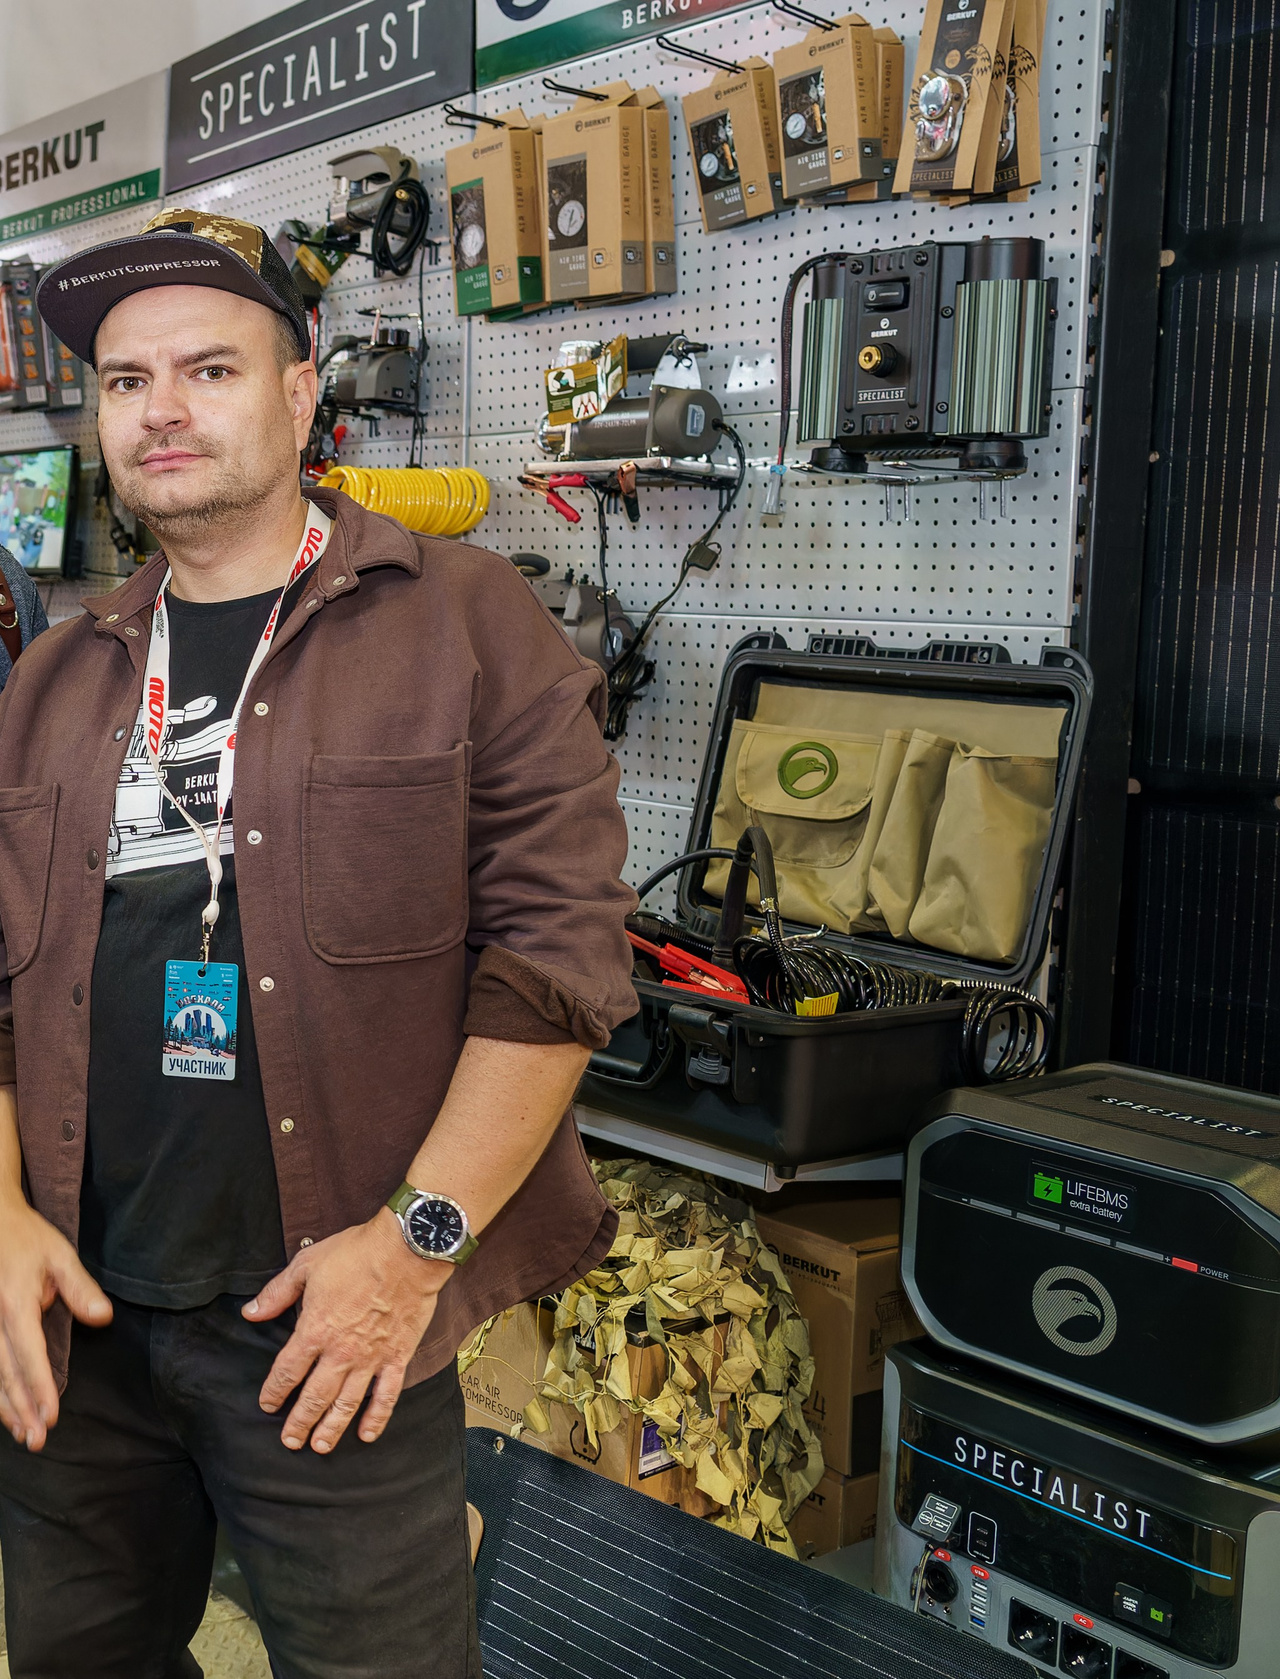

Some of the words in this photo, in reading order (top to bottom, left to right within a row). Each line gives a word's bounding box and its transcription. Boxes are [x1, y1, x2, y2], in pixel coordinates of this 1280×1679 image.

[621, 0, 703, 30] BERKU
[946, 9, 977, 22] BERKUT
[198, 1, 426, 141] SPECIALIST
[51, 181, 146, 225] PROFESSIONAL
[870, 328, 898, 339] BERKUT
[858, 389, 905, 402] SPECIALIST
[148, 677, 165, 755] MOTO
[169, 1058, 227, 1076] УЧАСТНИК
[1101, 1096, 1262, 1137] SPECIALIST
[1066, 1179, 1129, 1210] LIFEBMS
[1069, 1199, 1091, 1213] extra
[1092, 1202, 1123, 1223] battery
[783, 1252, 841, 1282] BERKUT
[1200, 1266, 1230, 1281] POWER
[461, 1385, 523, 1424] OMPRESSOR
[485, 1383, 501, 1400] AIR
[954, 1436, 1151, 1539] SPECIALIST
[1077, 1617, 1088, 1626] AC
